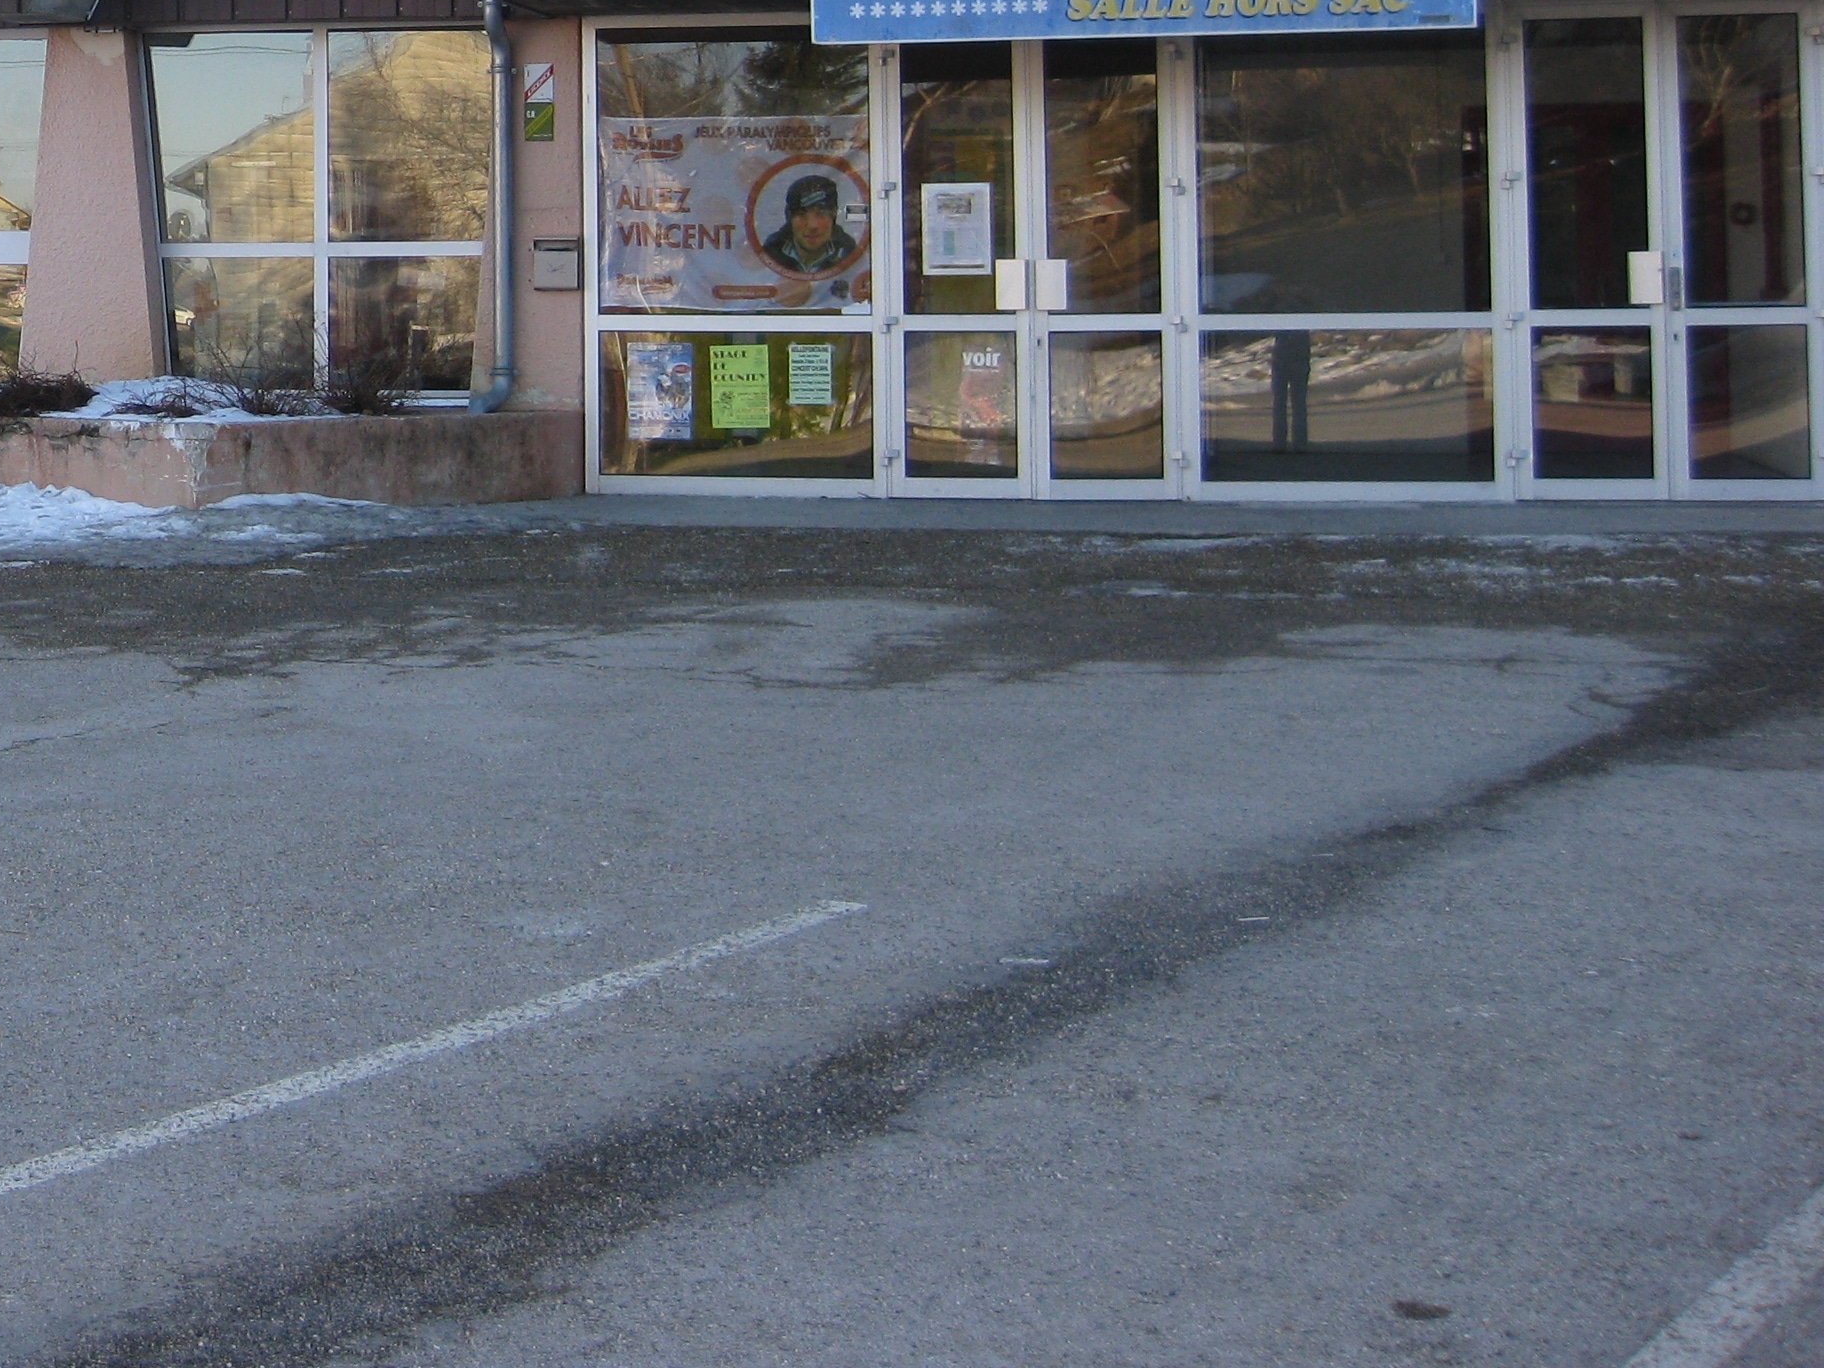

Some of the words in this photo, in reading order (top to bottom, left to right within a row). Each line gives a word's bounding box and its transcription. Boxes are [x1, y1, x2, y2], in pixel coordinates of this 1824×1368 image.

[617, 185, 691, 213] ALLEZ
[617, 221, 736, 250] VINCENT
[713, 350, 748, 358] STAGE
[962, 347, 1001, 366] voir
[713, 362, 728, 370] DE
[714, 373, 766, 382] COUNTRY
